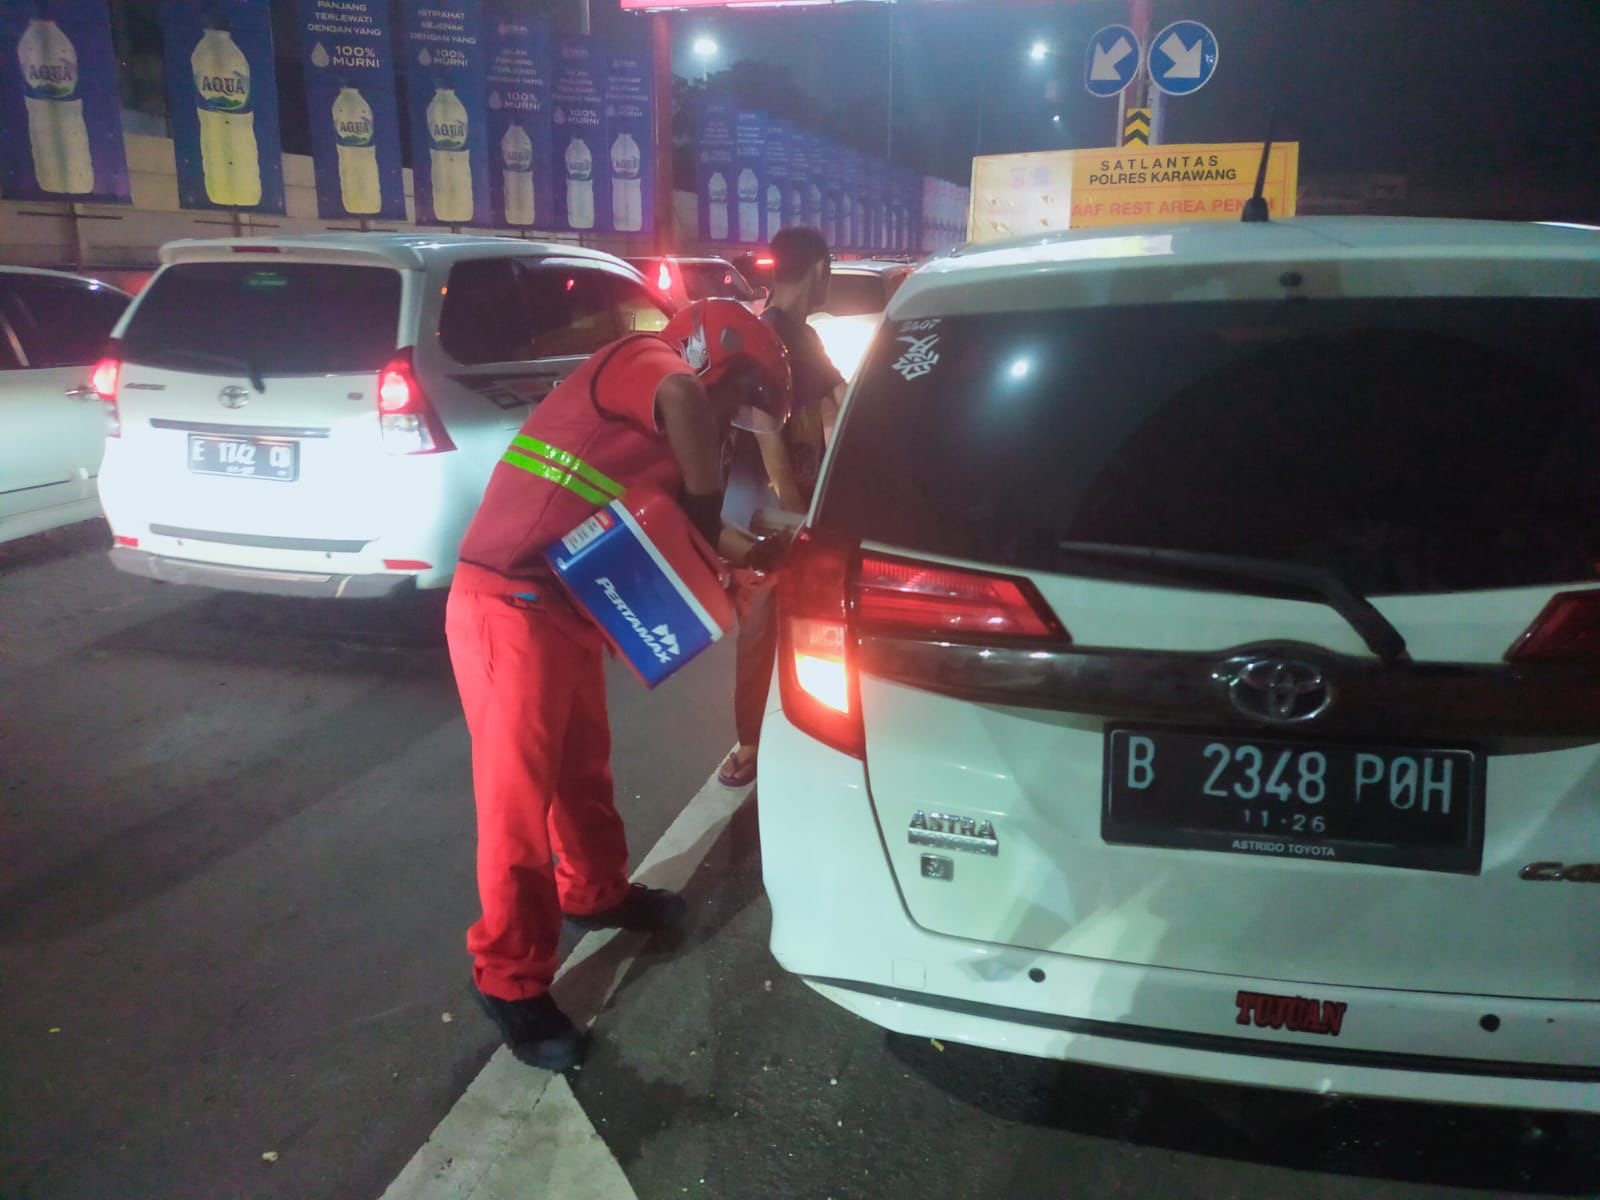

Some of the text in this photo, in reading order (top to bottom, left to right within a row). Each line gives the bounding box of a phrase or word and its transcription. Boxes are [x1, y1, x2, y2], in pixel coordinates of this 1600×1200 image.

[317, 1, 367, 12] PANJANG
[315, 13, 373, 24] TERLEWATI
[354, 27, 381, 37] YANG
[452, 35, 477, 45] YANG
[335, 45, 376, 58] 100%
[332, 57, 380, 68] MURNI
[433, 57, 468, 67] MURNI
[29, 64, 73, 83] AQUA
[202, 75, 246, 95] AQUA
[339, 120, 370, 135] AQUA
[433, 123, 465, 137] AQUA
[1101, 155, 1219, 171] SATLANTAS
[1089, 168, 1237, 185] POLRES KARAWANG
[1110, 201, 1155, 216] REST
[1158, 199, 1206, 214] AREA
[595, 577, 672, 664] PERTAMAX
[1128, 736, 1155, 789] B
[1203, 742, 1327, 804] 2348
[1232, 840, 1336, 856] ASTRIDO TOYOTA
